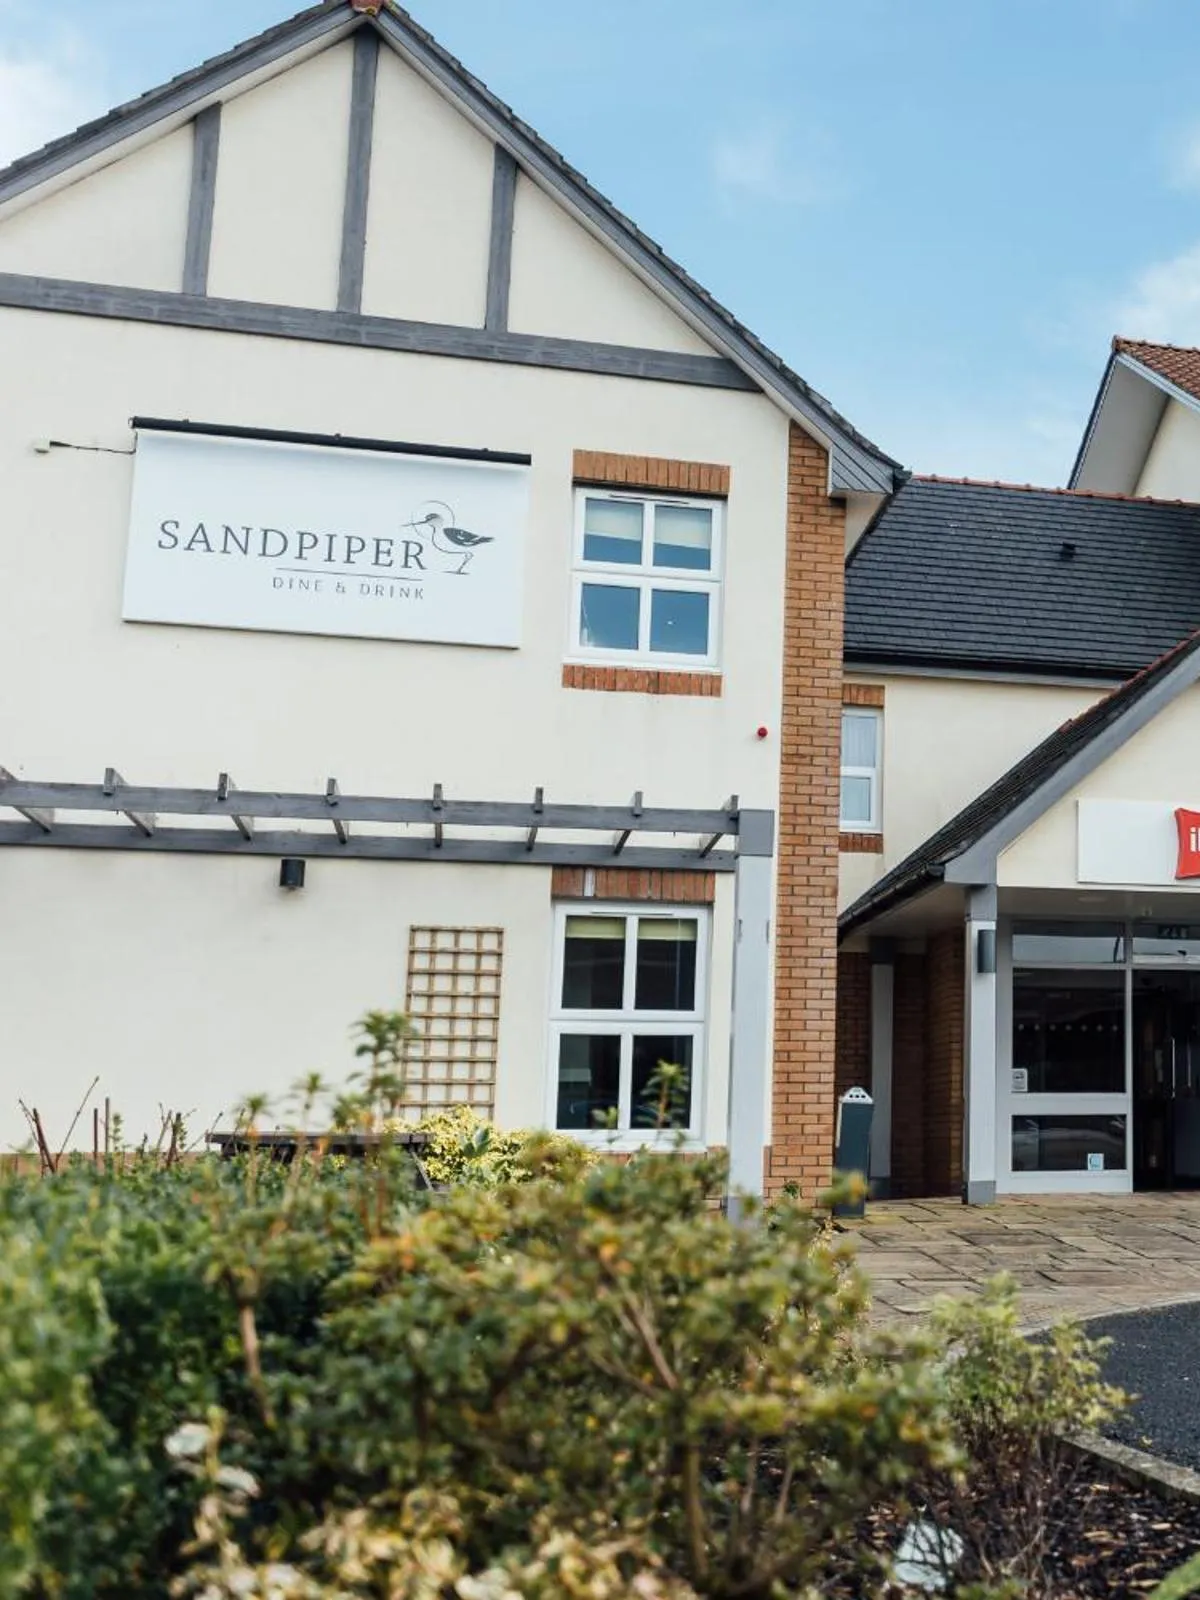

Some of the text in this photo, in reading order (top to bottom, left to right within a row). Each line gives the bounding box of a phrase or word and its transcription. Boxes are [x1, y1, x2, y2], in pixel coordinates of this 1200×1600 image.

[157, 519, 428, 571] SANDPIPER
[272, 576, 425, 600] DINE & DRINK
